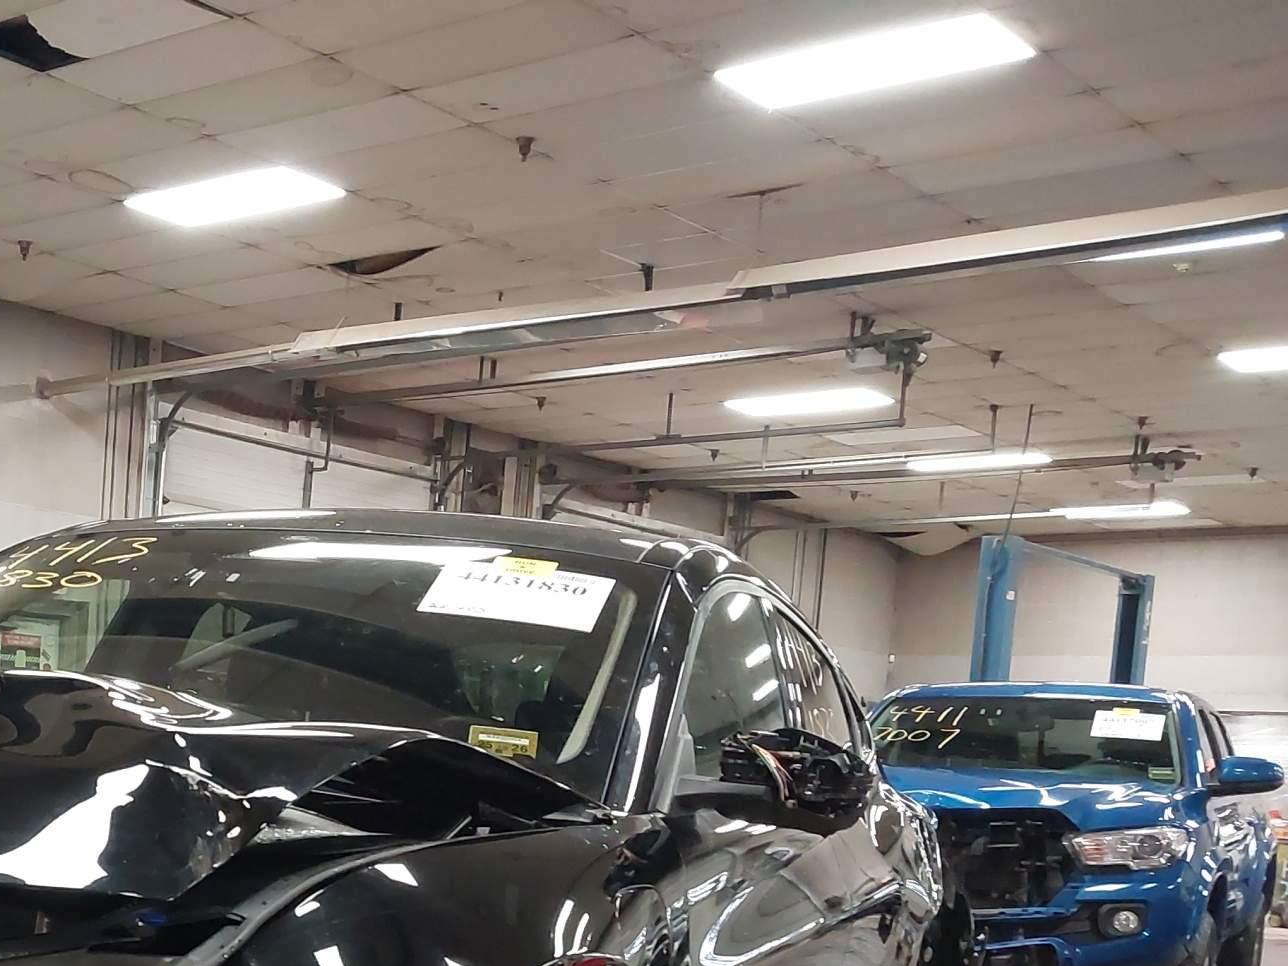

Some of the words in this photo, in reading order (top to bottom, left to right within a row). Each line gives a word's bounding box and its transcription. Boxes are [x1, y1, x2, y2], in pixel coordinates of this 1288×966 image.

[8, 537, 158, 569] 4413
[458, 572, 589, 597] 44131830
[889, 705, 969, 727] 4411
[512, 744, 529, 754] 26
[873, 726, 961, 749] 7007
